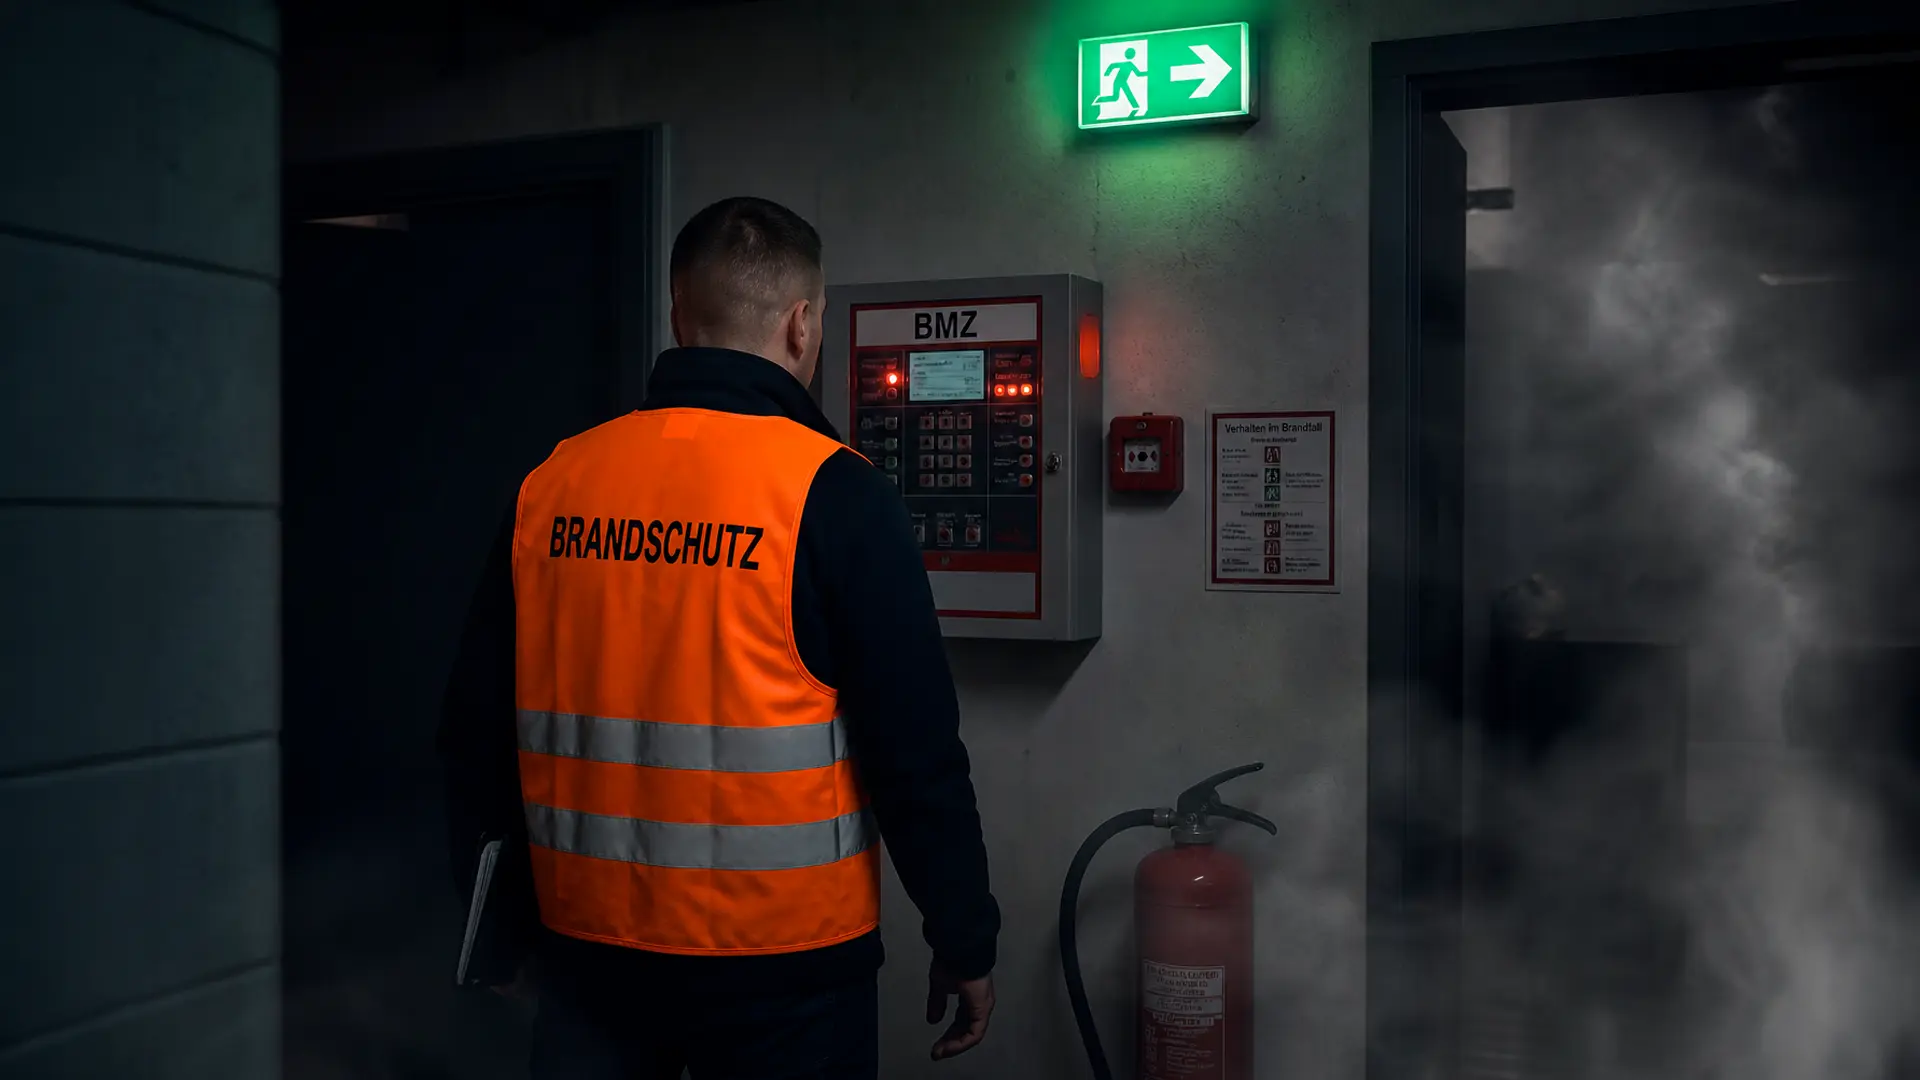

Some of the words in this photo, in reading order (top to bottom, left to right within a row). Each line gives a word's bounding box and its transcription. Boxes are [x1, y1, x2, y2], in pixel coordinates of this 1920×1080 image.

[915, 311, 977, 339] BMZ
[1225, 423, 1266, 434] Verhalten
[1269, 422, 1279, 433] im
[1282, 422, 1322, 433] Brandfall
[549, 516, 764, 570] BRANDSCHUTZ
